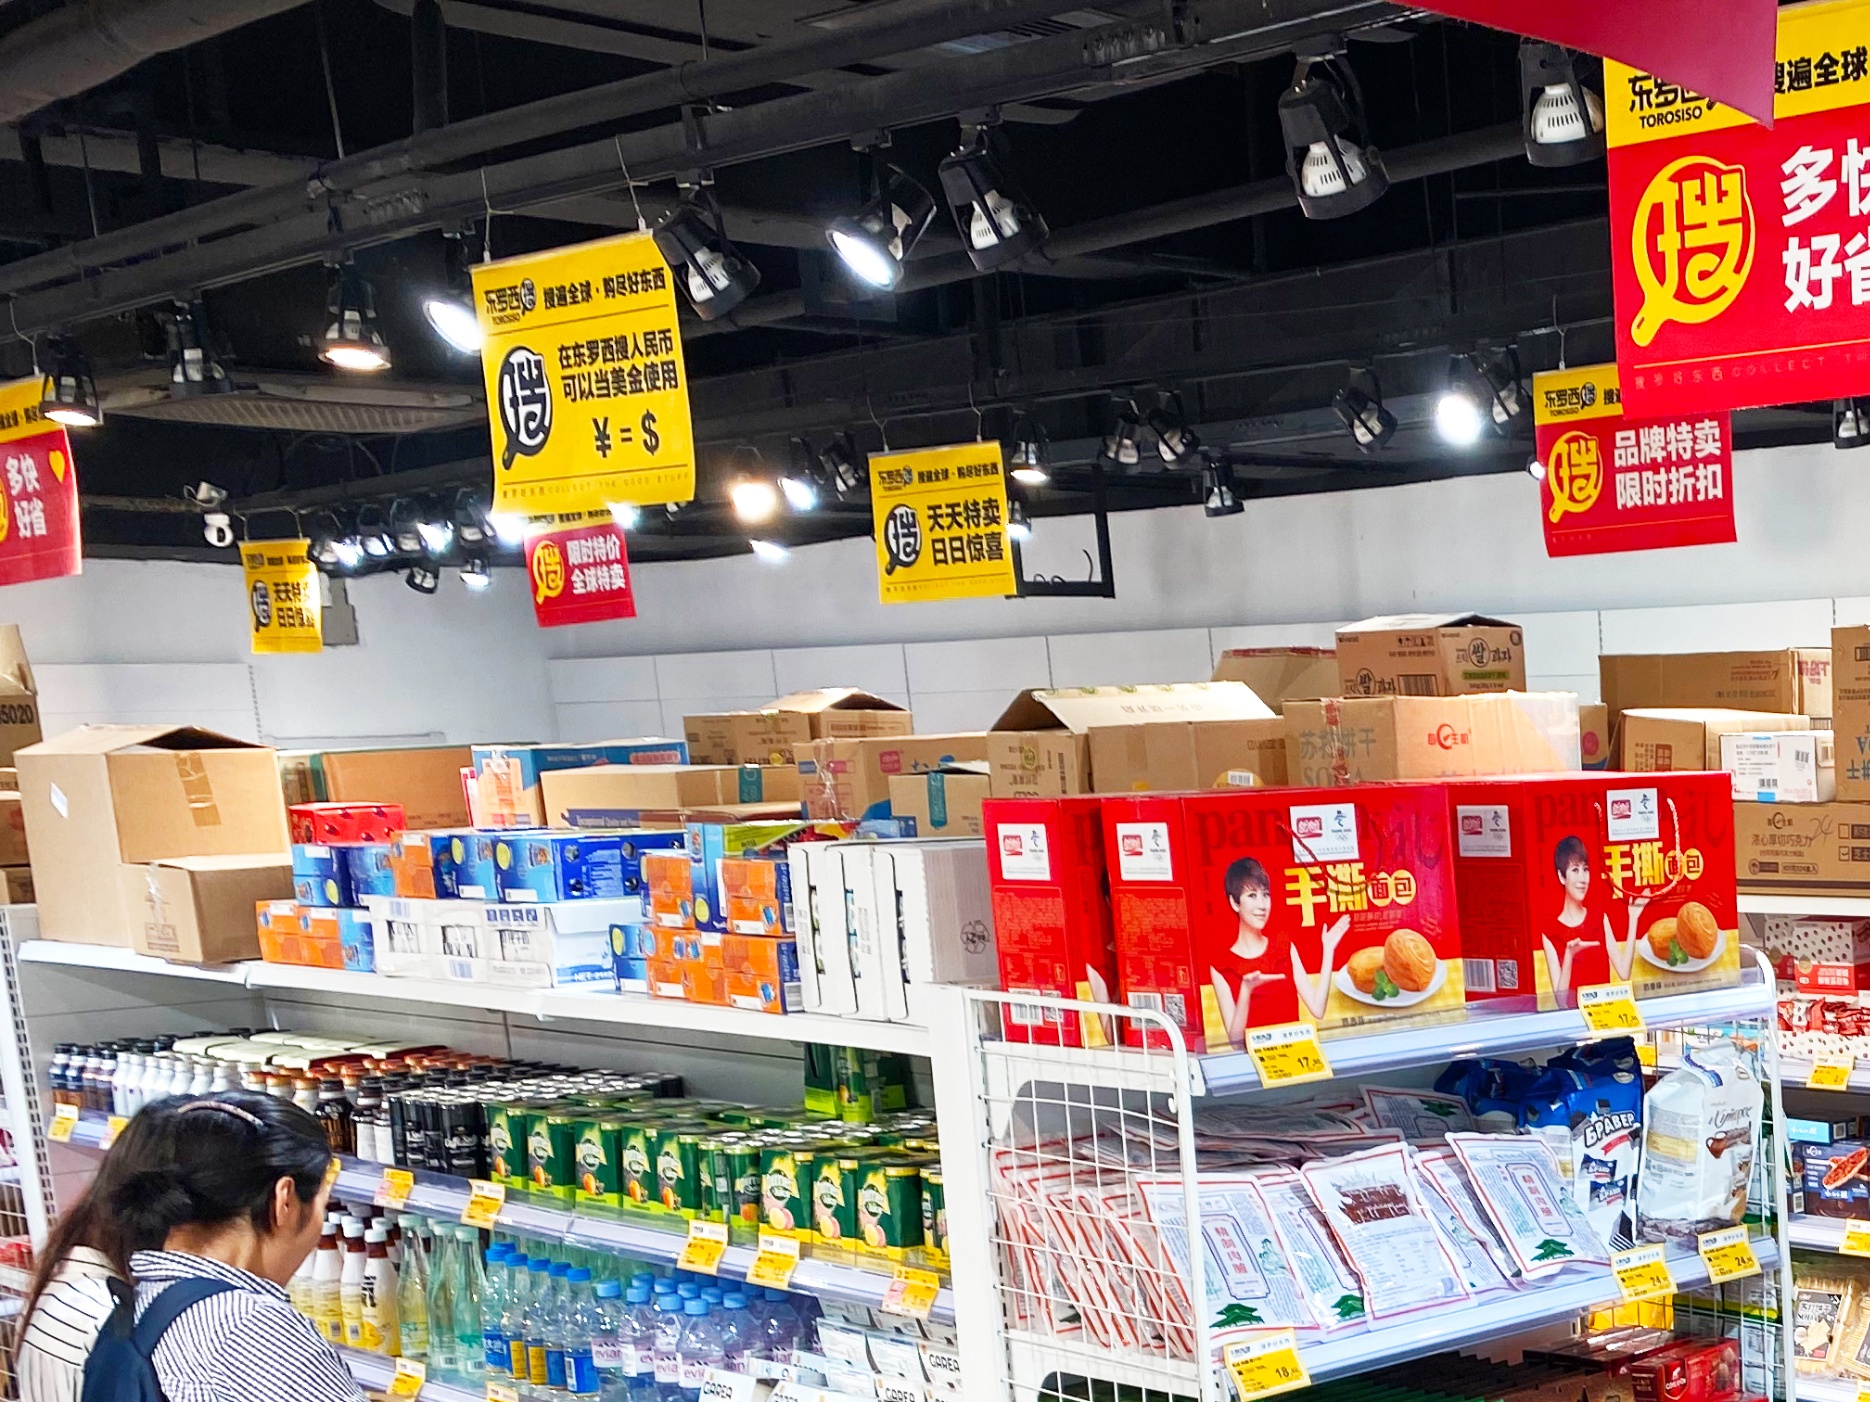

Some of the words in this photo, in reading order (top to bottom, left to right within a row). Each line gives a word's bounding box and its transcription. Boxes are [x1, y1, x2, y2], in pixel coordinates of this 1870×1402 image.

[1638, 105, 1703, 130] TOROSISO
[557, 328, 674, 369] 在东罗西搜人民币
[561, 360, 679, 402] 可以当美金使用
[592, 416, 612, 458] ¥
[641, 409, 660, 456] $
[1613, 419, 1722, 468] 品牌特卖
[5, 453, 40, 497] 多快
[1615, 464, 1724, 511] 限时折扣
[13, 496, 47, 539] 好省
[926, 497, 1001, 533] 天天特卖
[931, 531, 1004, 566] 日日惊喜
[0, 703, 34, 725] 5020
[1603, 841, 1704, 899] 手撕面包
[1284, 862, 1417, 927] 手撕面包
[1584, 1110, 1635, 1148] БРАВЕР
[703, 1380, 733, 1401] GAREA
